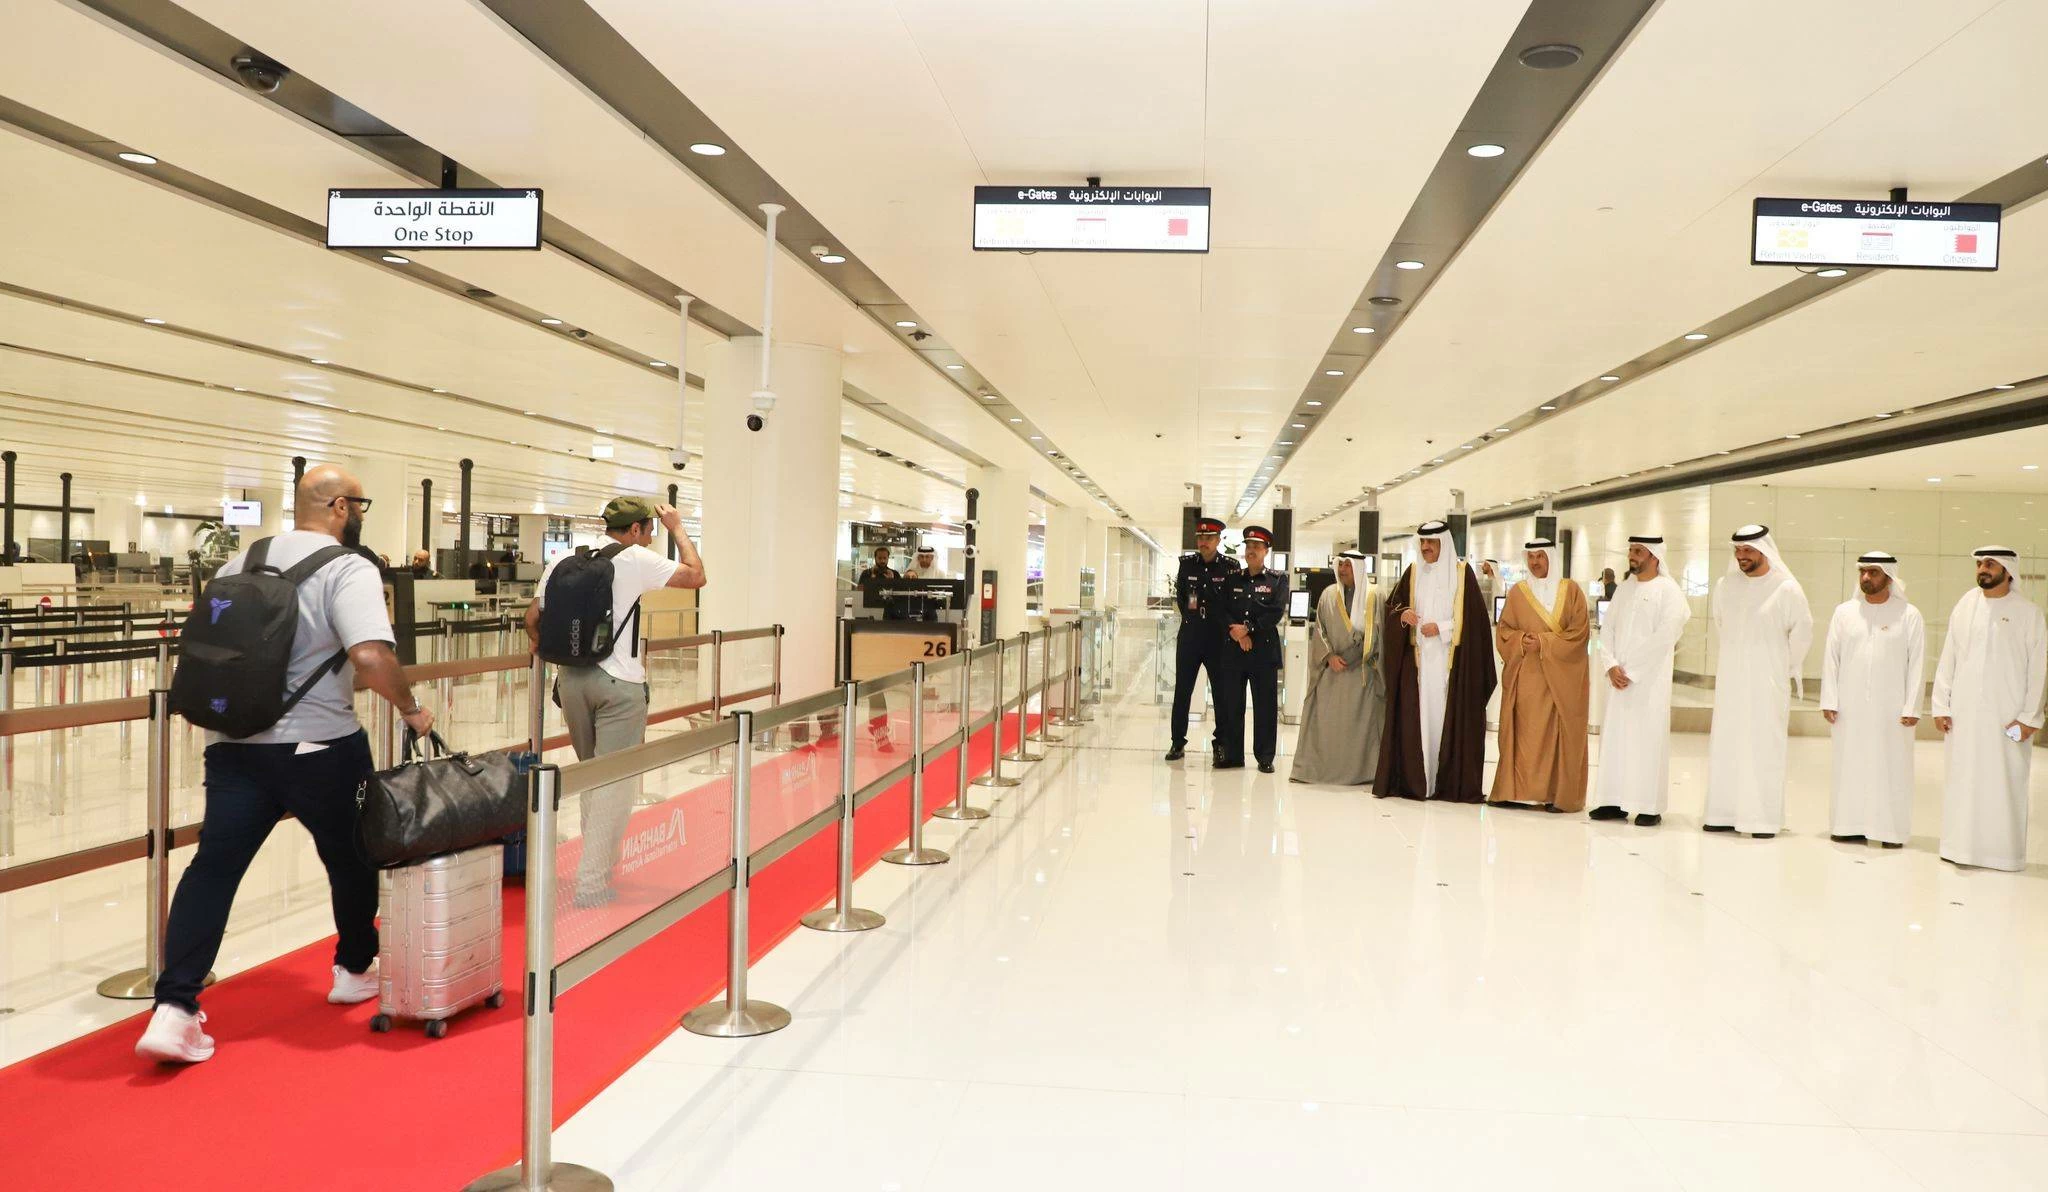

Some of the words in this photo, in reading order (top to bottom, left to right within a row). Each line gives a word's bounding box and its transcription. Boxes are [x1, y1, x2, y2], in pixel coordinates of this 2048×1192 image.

[330, 191, 341, 199] 25
[525, 190, 537, 199] 26
[1018, 189, 1057, 201] e-Gates
[1069, 190, 1120, 203] الإلكترونية
[1123, 190, 1162, 202] البوابات
[373, 201, 432, 222] الواحدة
[438, 201, 495, 216] النقطة
[1801, 201, 1843, 214] e-Gates
[1854, 203, 1908, 217] الإلكترونية
[1910, 205, 1951, 216] البوابات
[394, 227, 429, 241] One
[435, 227, 473, 245] Stop
[1856, 252, 1899, 262] Residents
[1943, 254, 1978, 264] Citizens
[570, 619, 581, 656] adidas
[923, 641, 947, 657] 26
